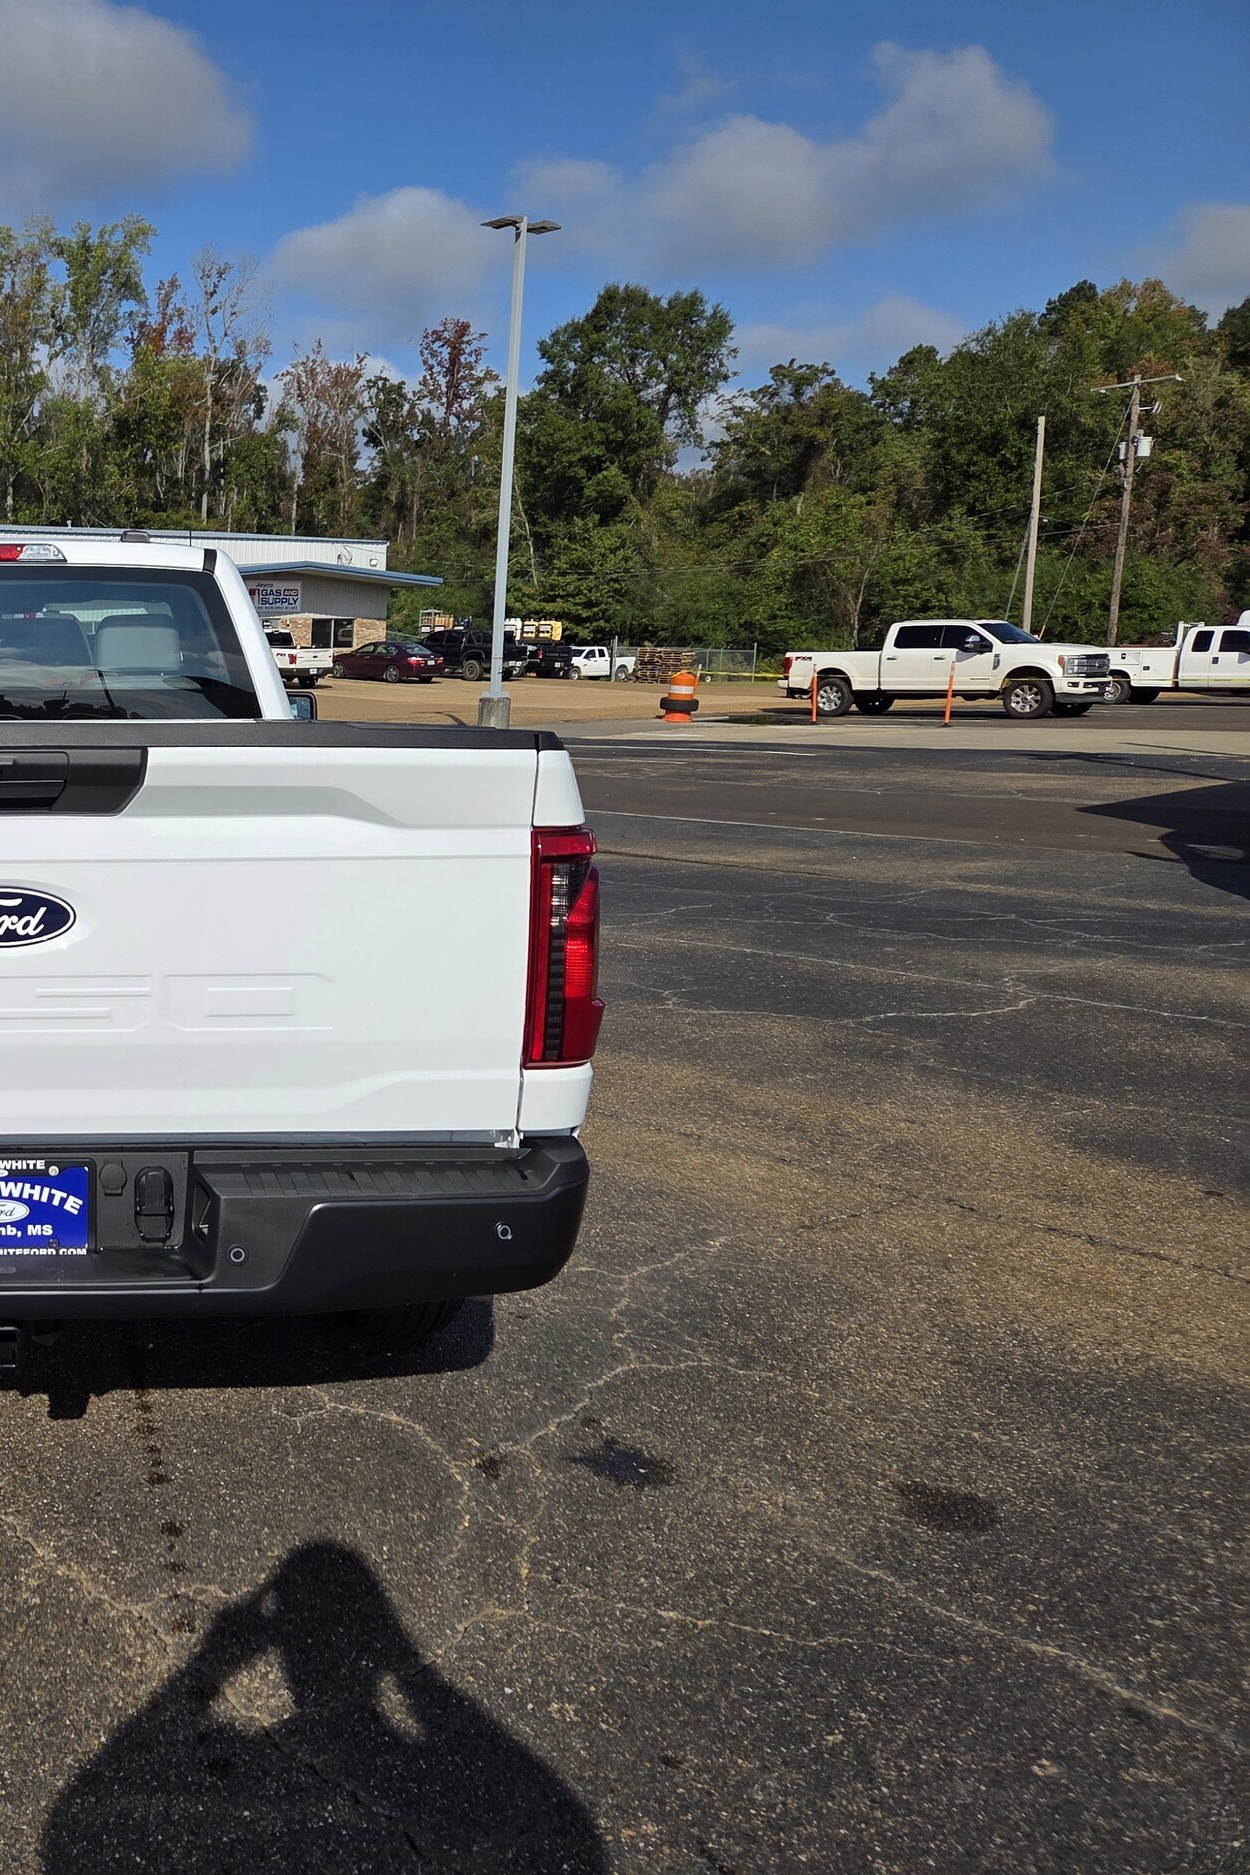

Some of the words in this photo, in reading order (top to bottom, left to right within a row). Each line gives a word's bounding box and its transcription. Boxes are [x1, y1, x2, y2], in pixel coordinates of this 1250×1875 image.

[261, 589, 282, 597] GAS
[260, 597, 299, 605] SUPPLY
[0, 1160, 46, 1170] WHITE
[0, 1181, 84, 1216] WHITE
[27, 1225, 53, 1237] MS
